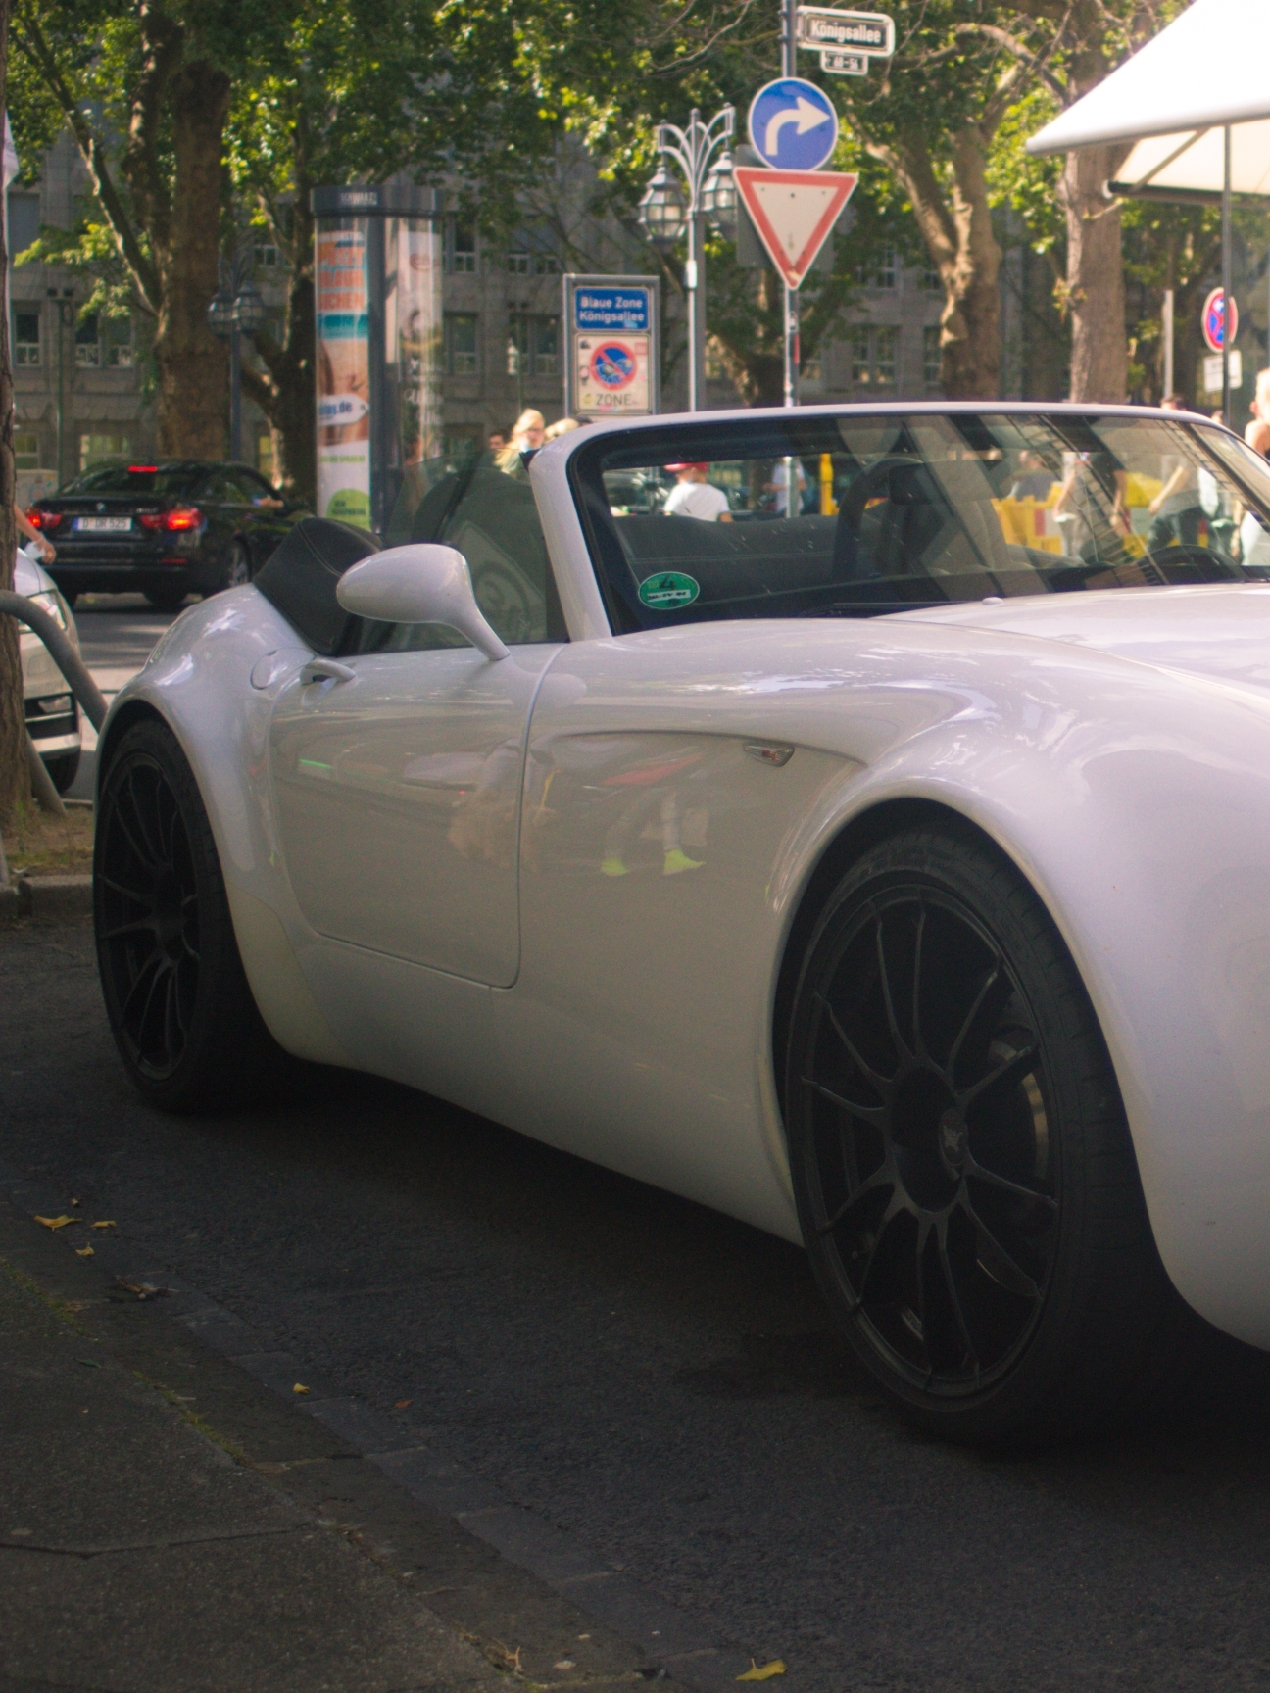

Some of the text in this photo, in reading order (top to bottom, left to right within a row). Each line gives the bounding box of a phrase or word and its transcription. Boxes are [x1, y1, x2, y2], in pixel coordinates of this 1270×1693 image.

[810, 20, 881, 43] Königsallee
[581, 296, 643, 308] Blaue Zone
[580, 311, 645, 323] Königsallee
[595, 393, 631, 406] ZONE
[109, 519, 127, 528] 525
[659, 574, 676, 590] 4
